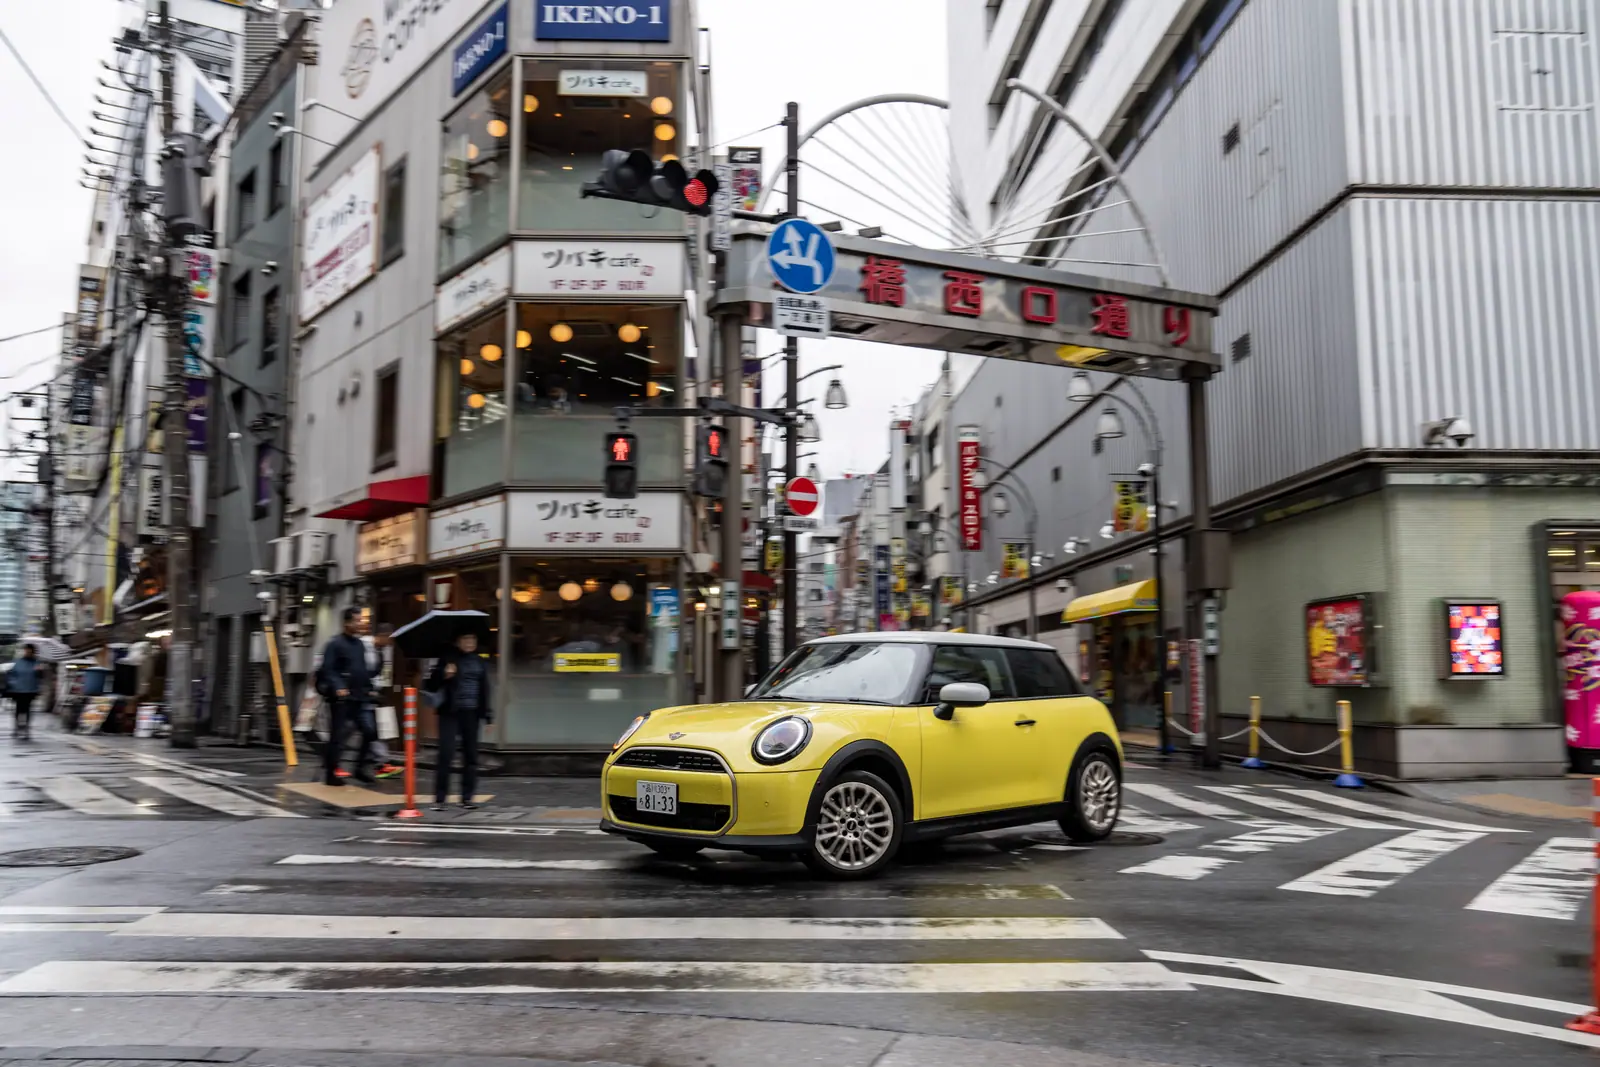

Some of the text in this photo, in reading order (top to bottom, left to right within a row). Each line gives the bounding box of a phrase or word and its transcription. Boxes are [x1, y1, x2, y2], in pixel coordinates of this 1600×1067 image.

[542, 5, 663, 24] IKENO-1
[773, 255, 1191, 346] 橋西口通り
[645, 794, 674, 811] 81-33
